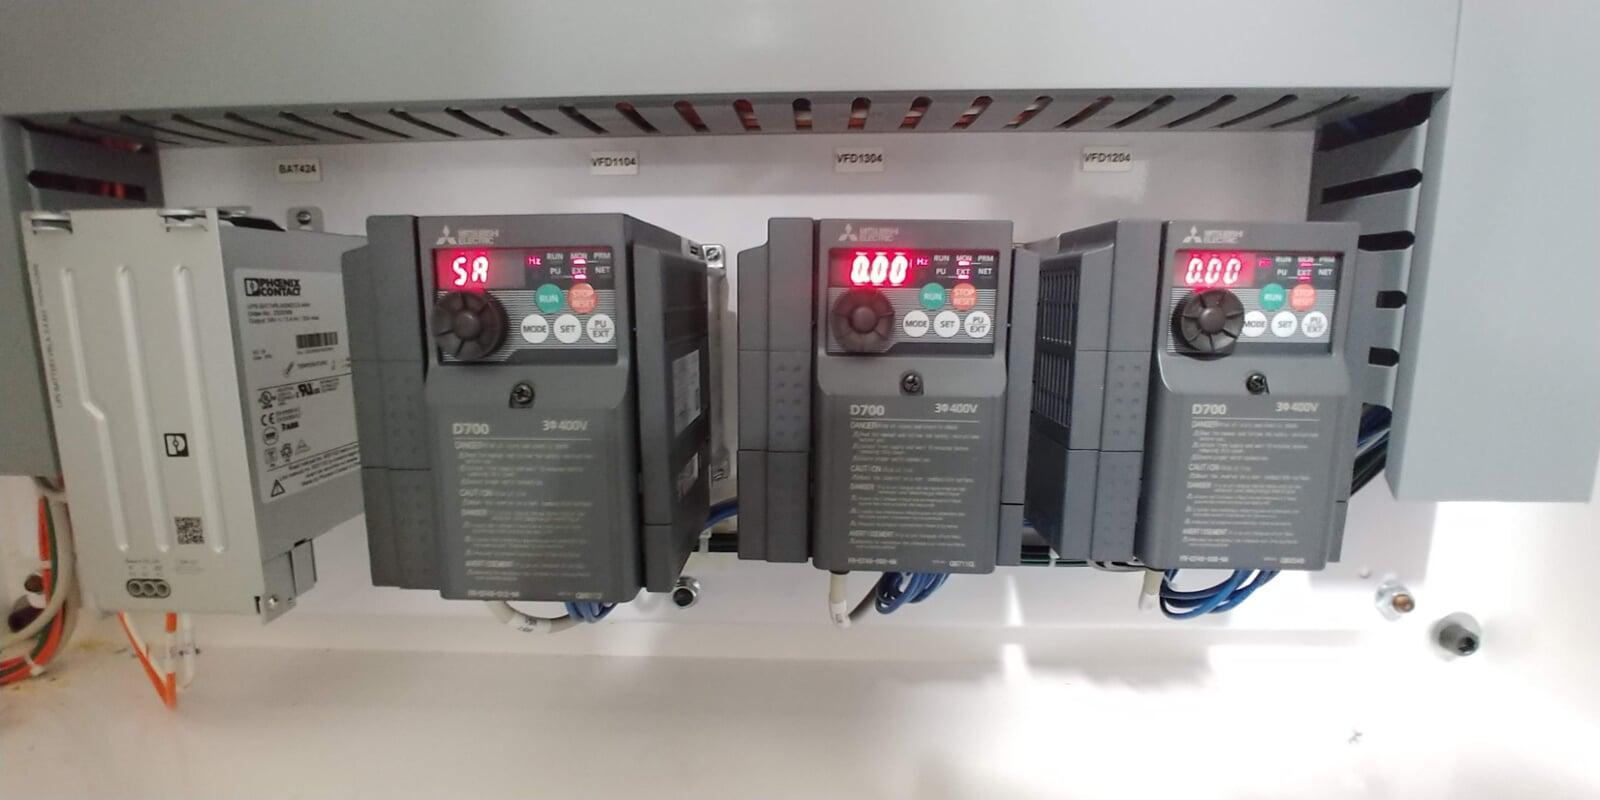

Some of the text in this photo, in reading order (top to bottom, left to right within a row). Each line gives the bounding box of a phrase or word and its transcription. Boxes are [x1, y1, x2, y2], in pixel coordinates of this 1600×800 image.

[591, 157, 637, 167] VFD1104
[837, 153, 883, 163] VFD1304
[1085, 152, 1131, 163] VFD1204
[279, 163, 317, 174] BAT424
[547, 253, 563, 261] RUN
[570, 252, 587, 260] MON
[528, 257, 542, 266] Hz
[917, 258, 928, 266] Hz
[572, 267, 587, 275] EXT
[595, 266, 610, 274] NET
[851, 253, 908, 285] 0.00
[1185, 258, 1241, 284] 0.00
[260, 287, 301, 297] CONTACT
[539, 294, 559, 304] RUN
[924, 293, 942, 301] RUN
[594, 320, 607, 328] PU
[1244, 320, 1265, 328] MODE
[523, 325, 547, 333] MODE
[560, 325, 576, 333] SET
[970, 325, 986, 333] EXT
[593, 330, 609, 338] EXT
[850, 405, 885, 416] D700
[1192, 404, 1227, 415] D700
[452, 423, 490, 435] D700
